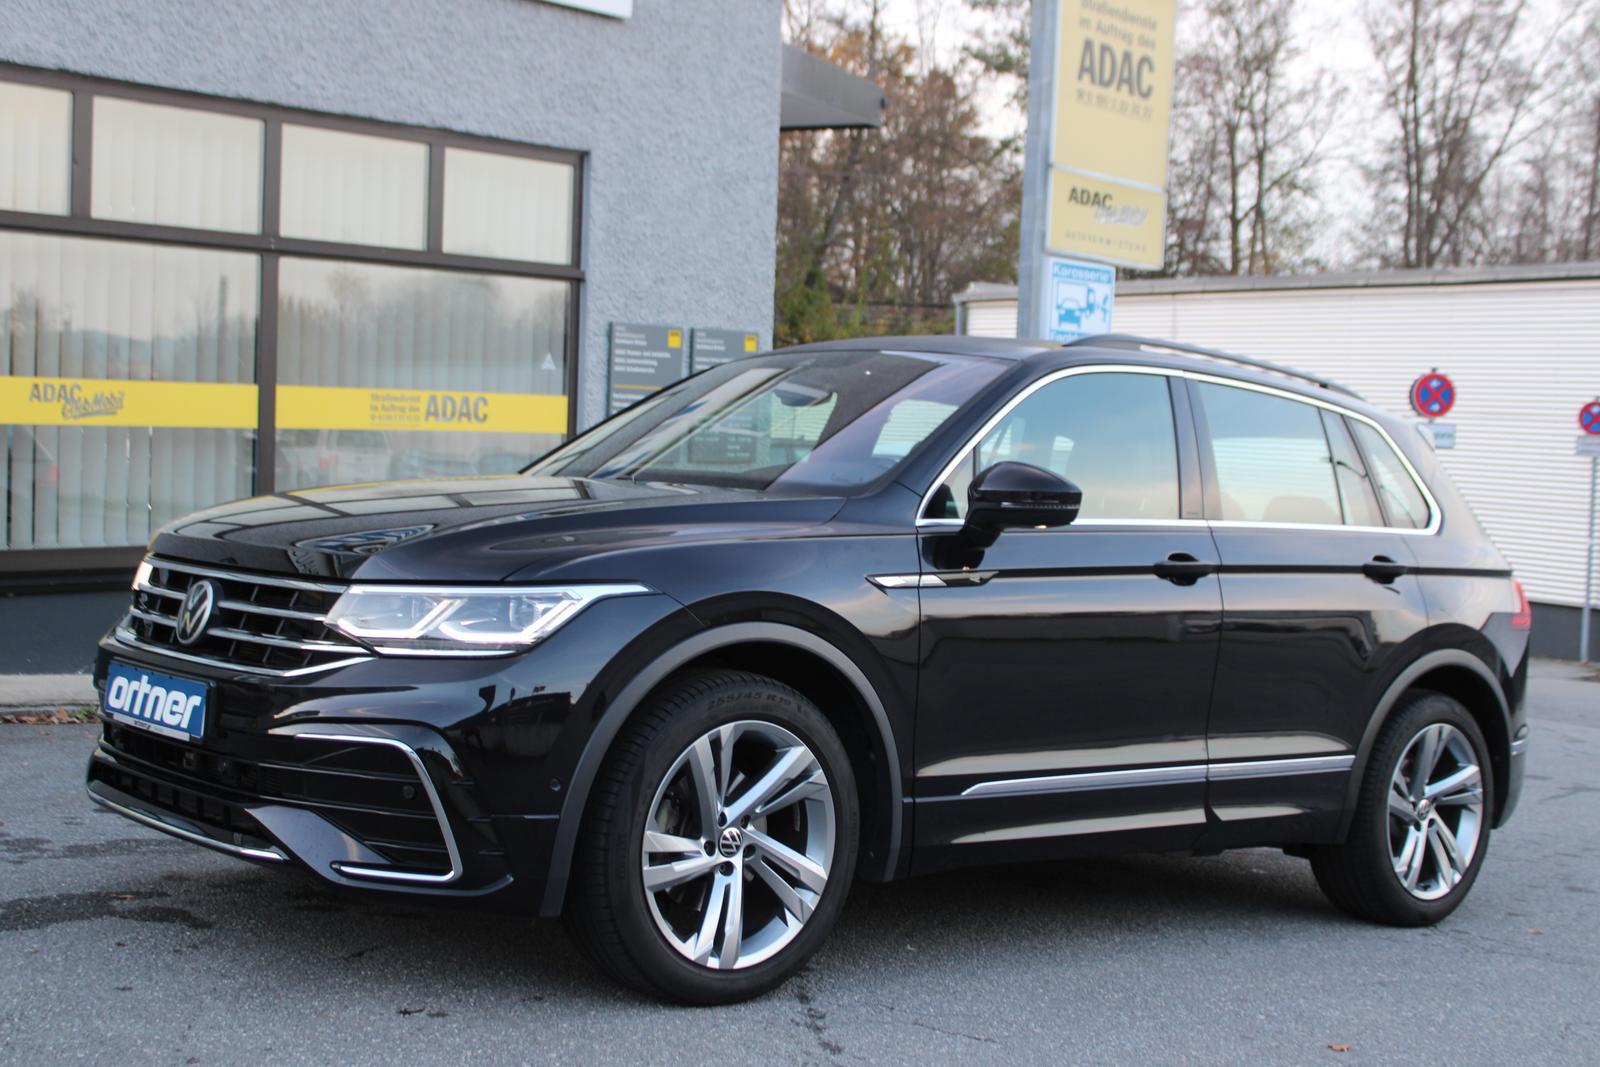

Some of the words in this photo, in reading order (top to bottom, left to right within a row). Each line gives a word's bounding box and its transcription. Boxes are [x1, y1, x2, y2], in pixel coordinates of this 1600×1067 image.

[1077, 37, 1155, 99] ADAC
[1068, 185, 1114, 211] ADAC
[29, 383, 82, 402] ADAC
[425, 394, 489, 423] ADAC
[108, 675, 202, 729] ortner
